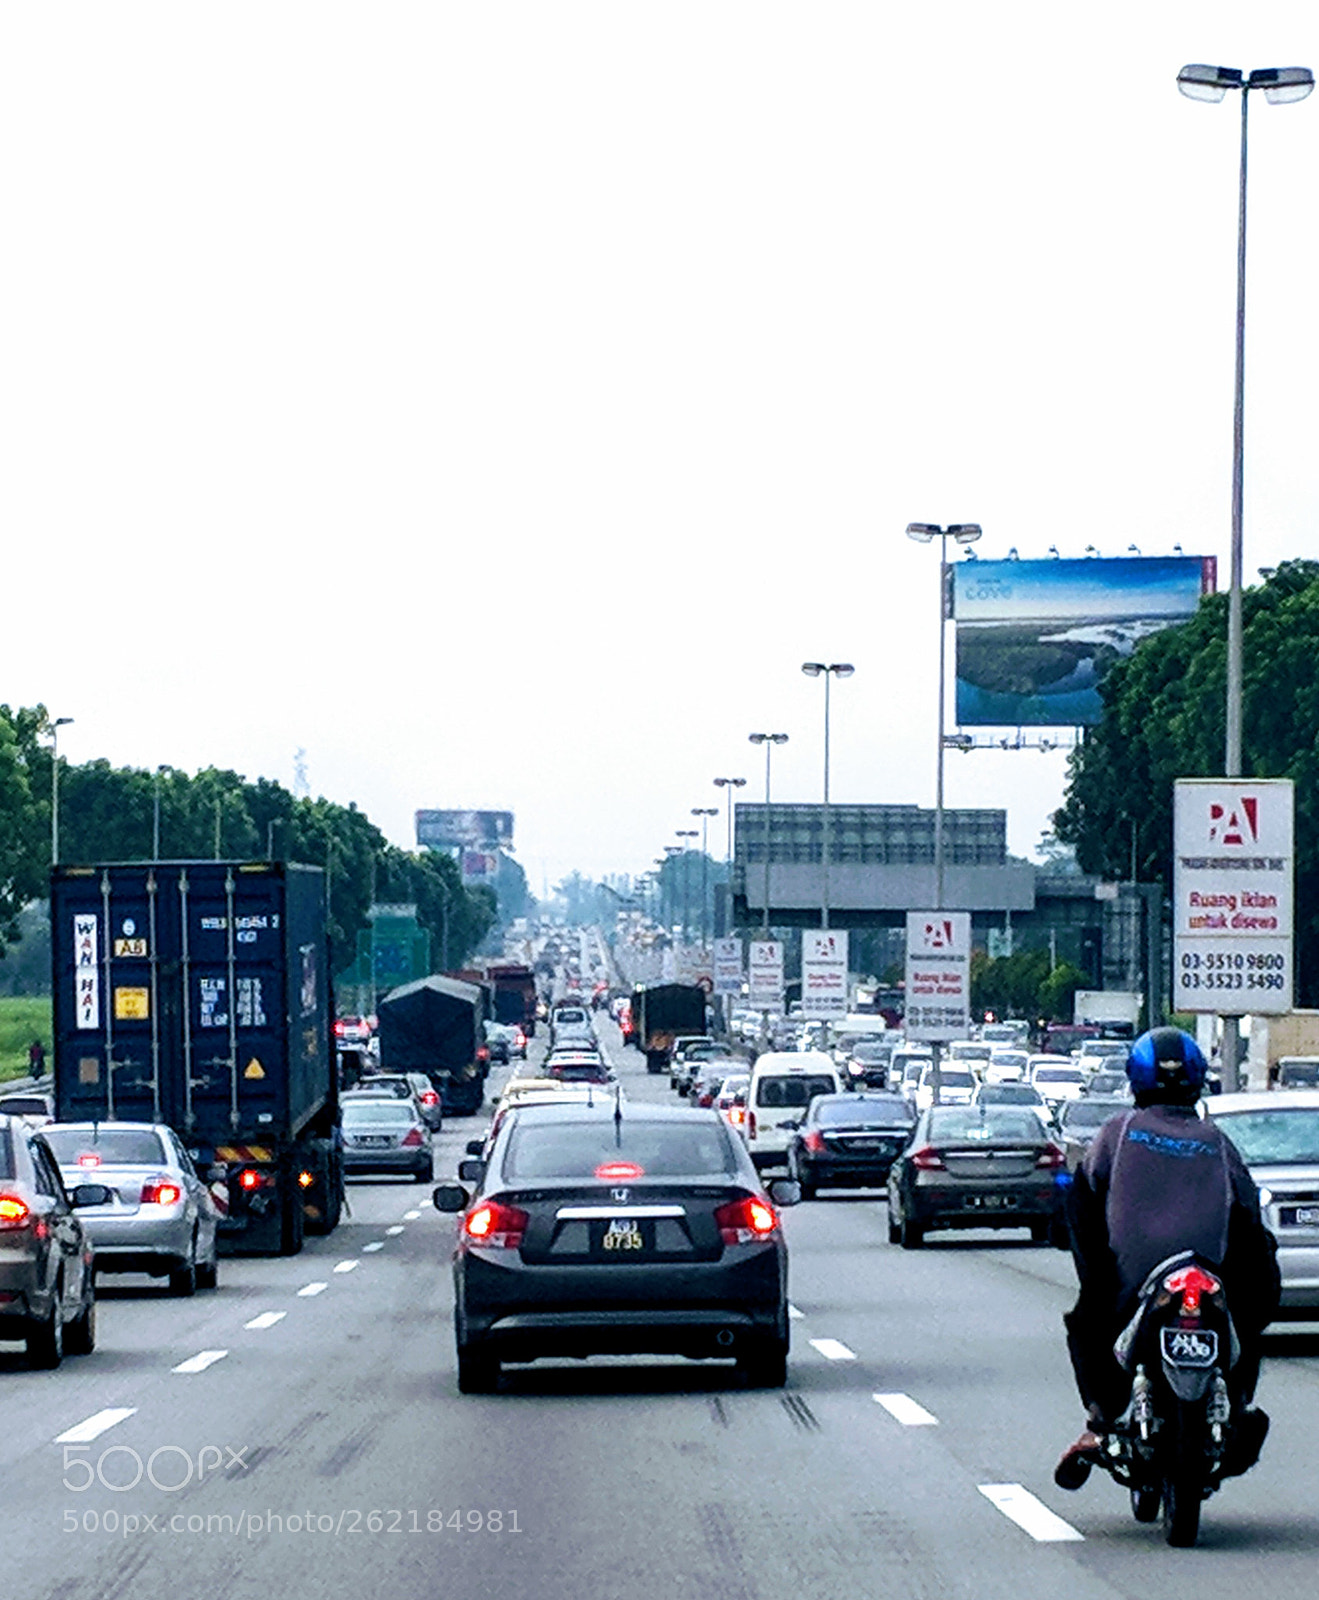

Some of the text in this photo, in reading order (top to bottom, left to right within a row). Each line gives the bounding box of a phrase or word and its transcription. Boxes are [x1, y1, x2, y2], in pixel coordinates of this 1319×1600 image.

[1189, 891, 1277, 911] Ruang iklan
[1189, 912, 1278, 930] untuk disewa
[78, 922, 94, 1021] WAN HAI
